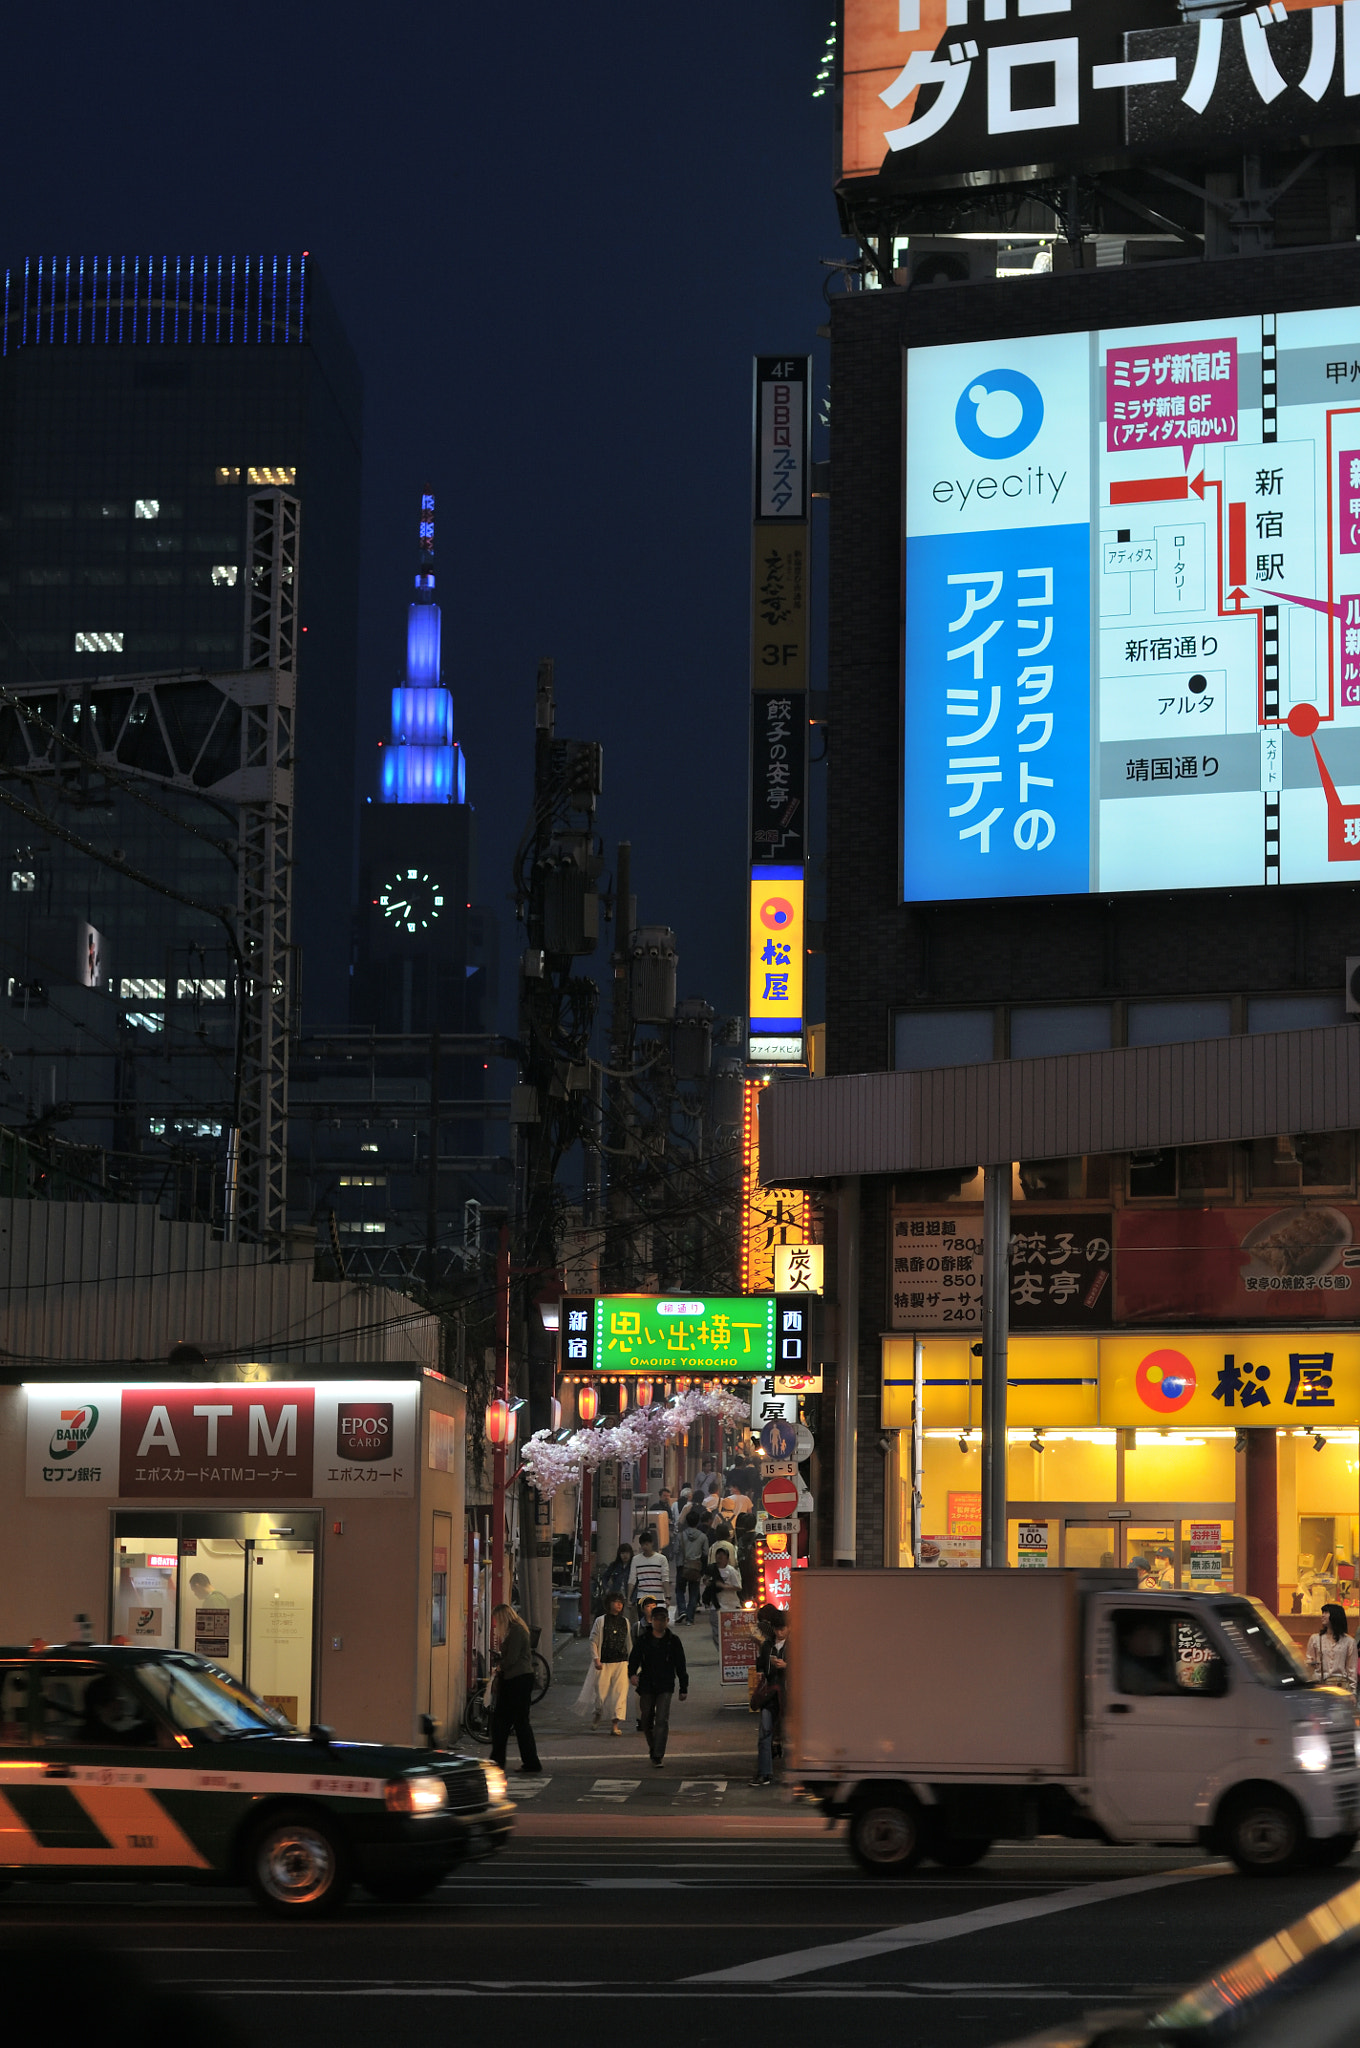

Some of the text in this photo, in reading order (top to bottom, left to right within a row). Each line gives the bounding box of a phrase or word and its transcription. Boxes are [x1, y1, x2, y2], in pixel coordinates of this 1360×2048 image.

[771, 362, 794, 378] 4F
[1113, 351, 1231, 388] ミラザ新宿店
[1113, 394, 1212, 420] ミラザ新宿 6F
[1113, 416, 1236, 446] (アディダス向かい)
[771, 385, 797, 513] BBQフェスタ
[932, 466, 1068, 511] eyecity
[1255, 468, 1285, 581] 新宿駅
[1108, 549, 1153, 564] アディダス
[1174, 536, 1186, 601] ロータリー
[762, 645, 798, 665] 3F
[1125, 636, 1218, 662] 新宿通り
[946, 570, 1004, 854] アイシティ
[1012, 566, 1056, 851] コンタクトの
[1158, 695, 1214, 715] アルタ
[1126, 756, 1218, 782] 靖国通り
[1266, 738, 1277, 783] 大ガード
[760, 938, 791, 1000] 松屋
[1011, 1231, 1109, 1266] 餃子の
[789, 1249, 811, 1290] 炭火
[895, 1256, 973, 1272] 黒酢の酢豚
[943, 1274, 984, 1287] 850
[1011, 1270, 1081, 1306] 安亭
[1246, 1276, 1350, 1291] 安亭の焼餃子(5個)
[943, 1309, 984, 1321] 240
[568, 1310, 588, 1358] 新宿
[608, 1311, 762, 1353] 思い出横丁
[782, 1310, 802, 1359] 西口
[630, 1356, 738, 1366] OMOIDE YOKOCHO
[1212, 1351, 1336, 1409] 松屋
[56, 1429, 88, 1440] BANK
[136, 1404, 298, 1457] ATM
[341, 1416, 389, 1436] EPOS
[348, 1437, 383, 1448] CARD
[42, 1466, 102, 1482] セブン銀行
[134, 1467, 297, 1482] エポスカードATMコーナー
[327, 1467, 403, 1482] エポスカード
[1192, 1530, 1220, 1540] お弁当
[1192, 1560, 1220, 1570] 無添加
